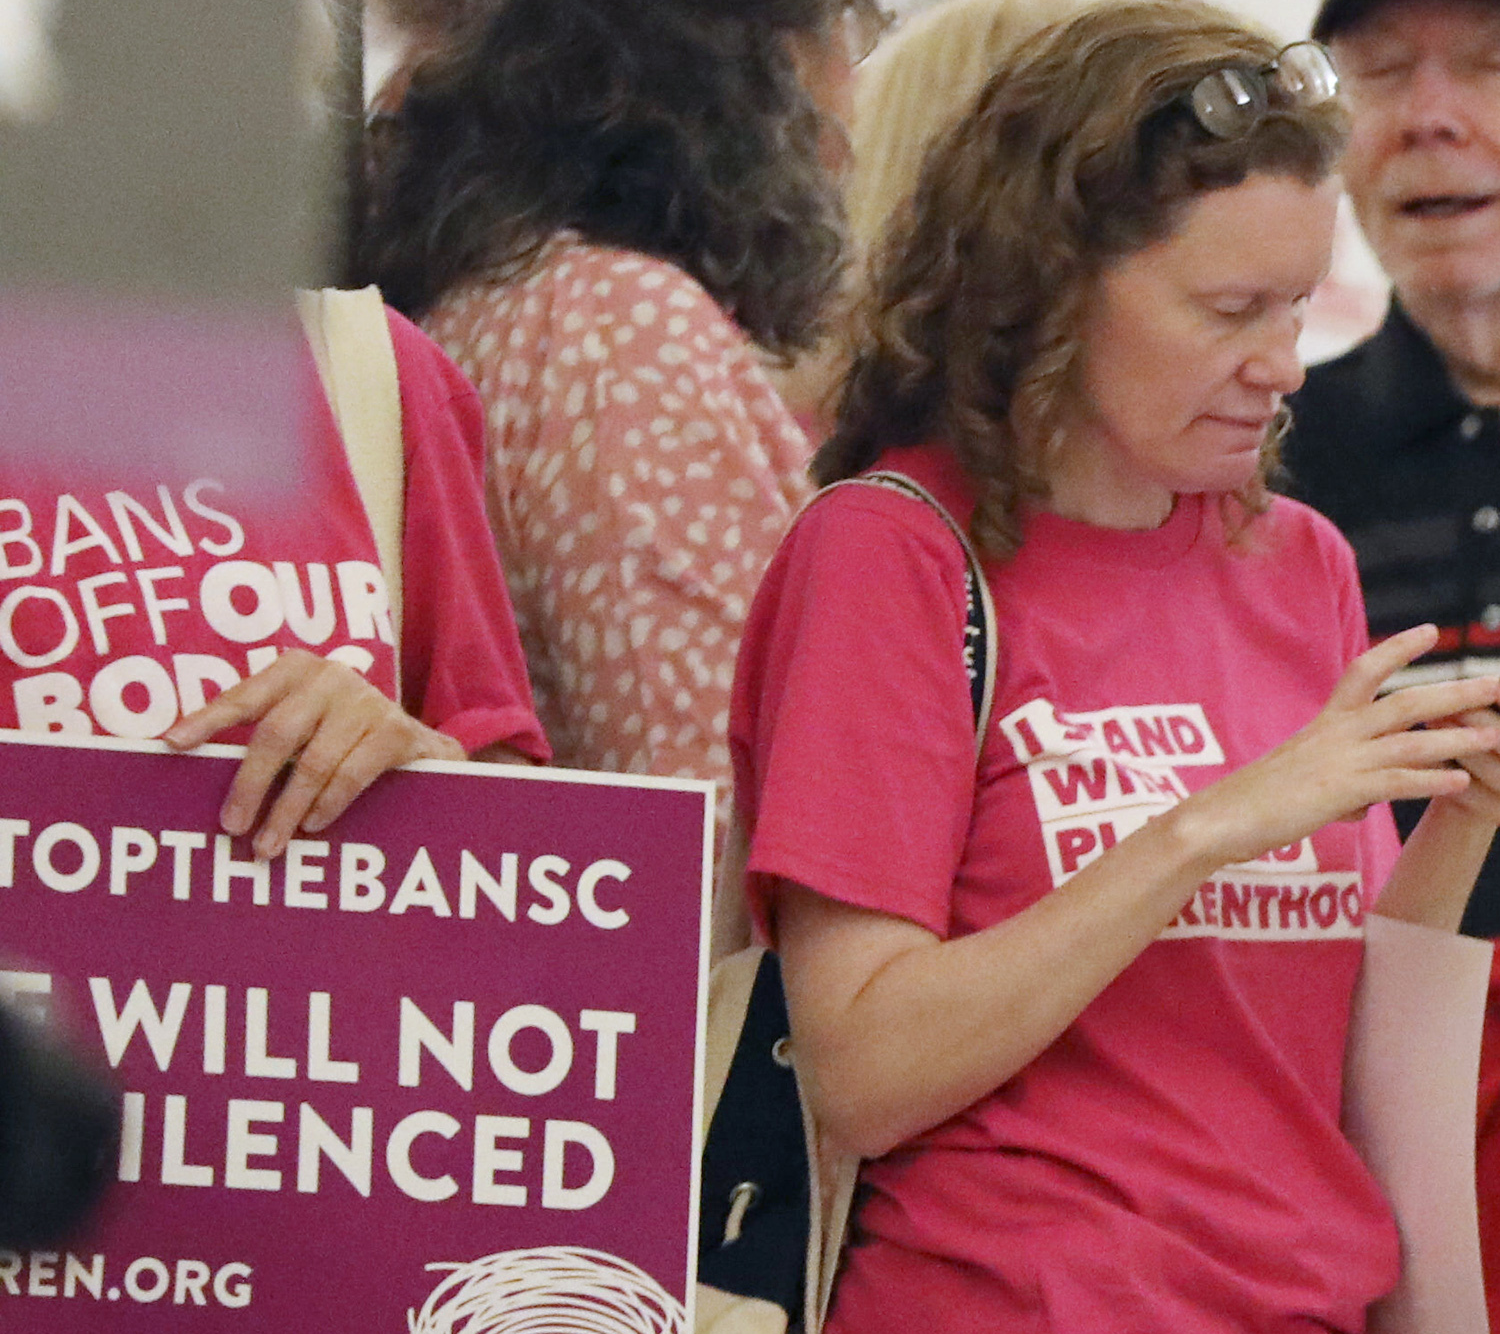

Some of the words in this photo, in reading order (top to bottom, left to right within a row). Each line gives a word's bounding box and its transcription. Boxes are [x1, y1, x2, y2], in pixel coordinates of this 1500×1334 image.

[0, 478, 246, 581] BANS
[0, 584, 190, 669] OFF
[199, 559, 398, 647] OUR
[12, 644, 375, 739] BOD
[88, 975, 361, 1084] WILL
[397, 995, 637, 1101] NOT
[117, 1091, 616, 1211] ILENCED
